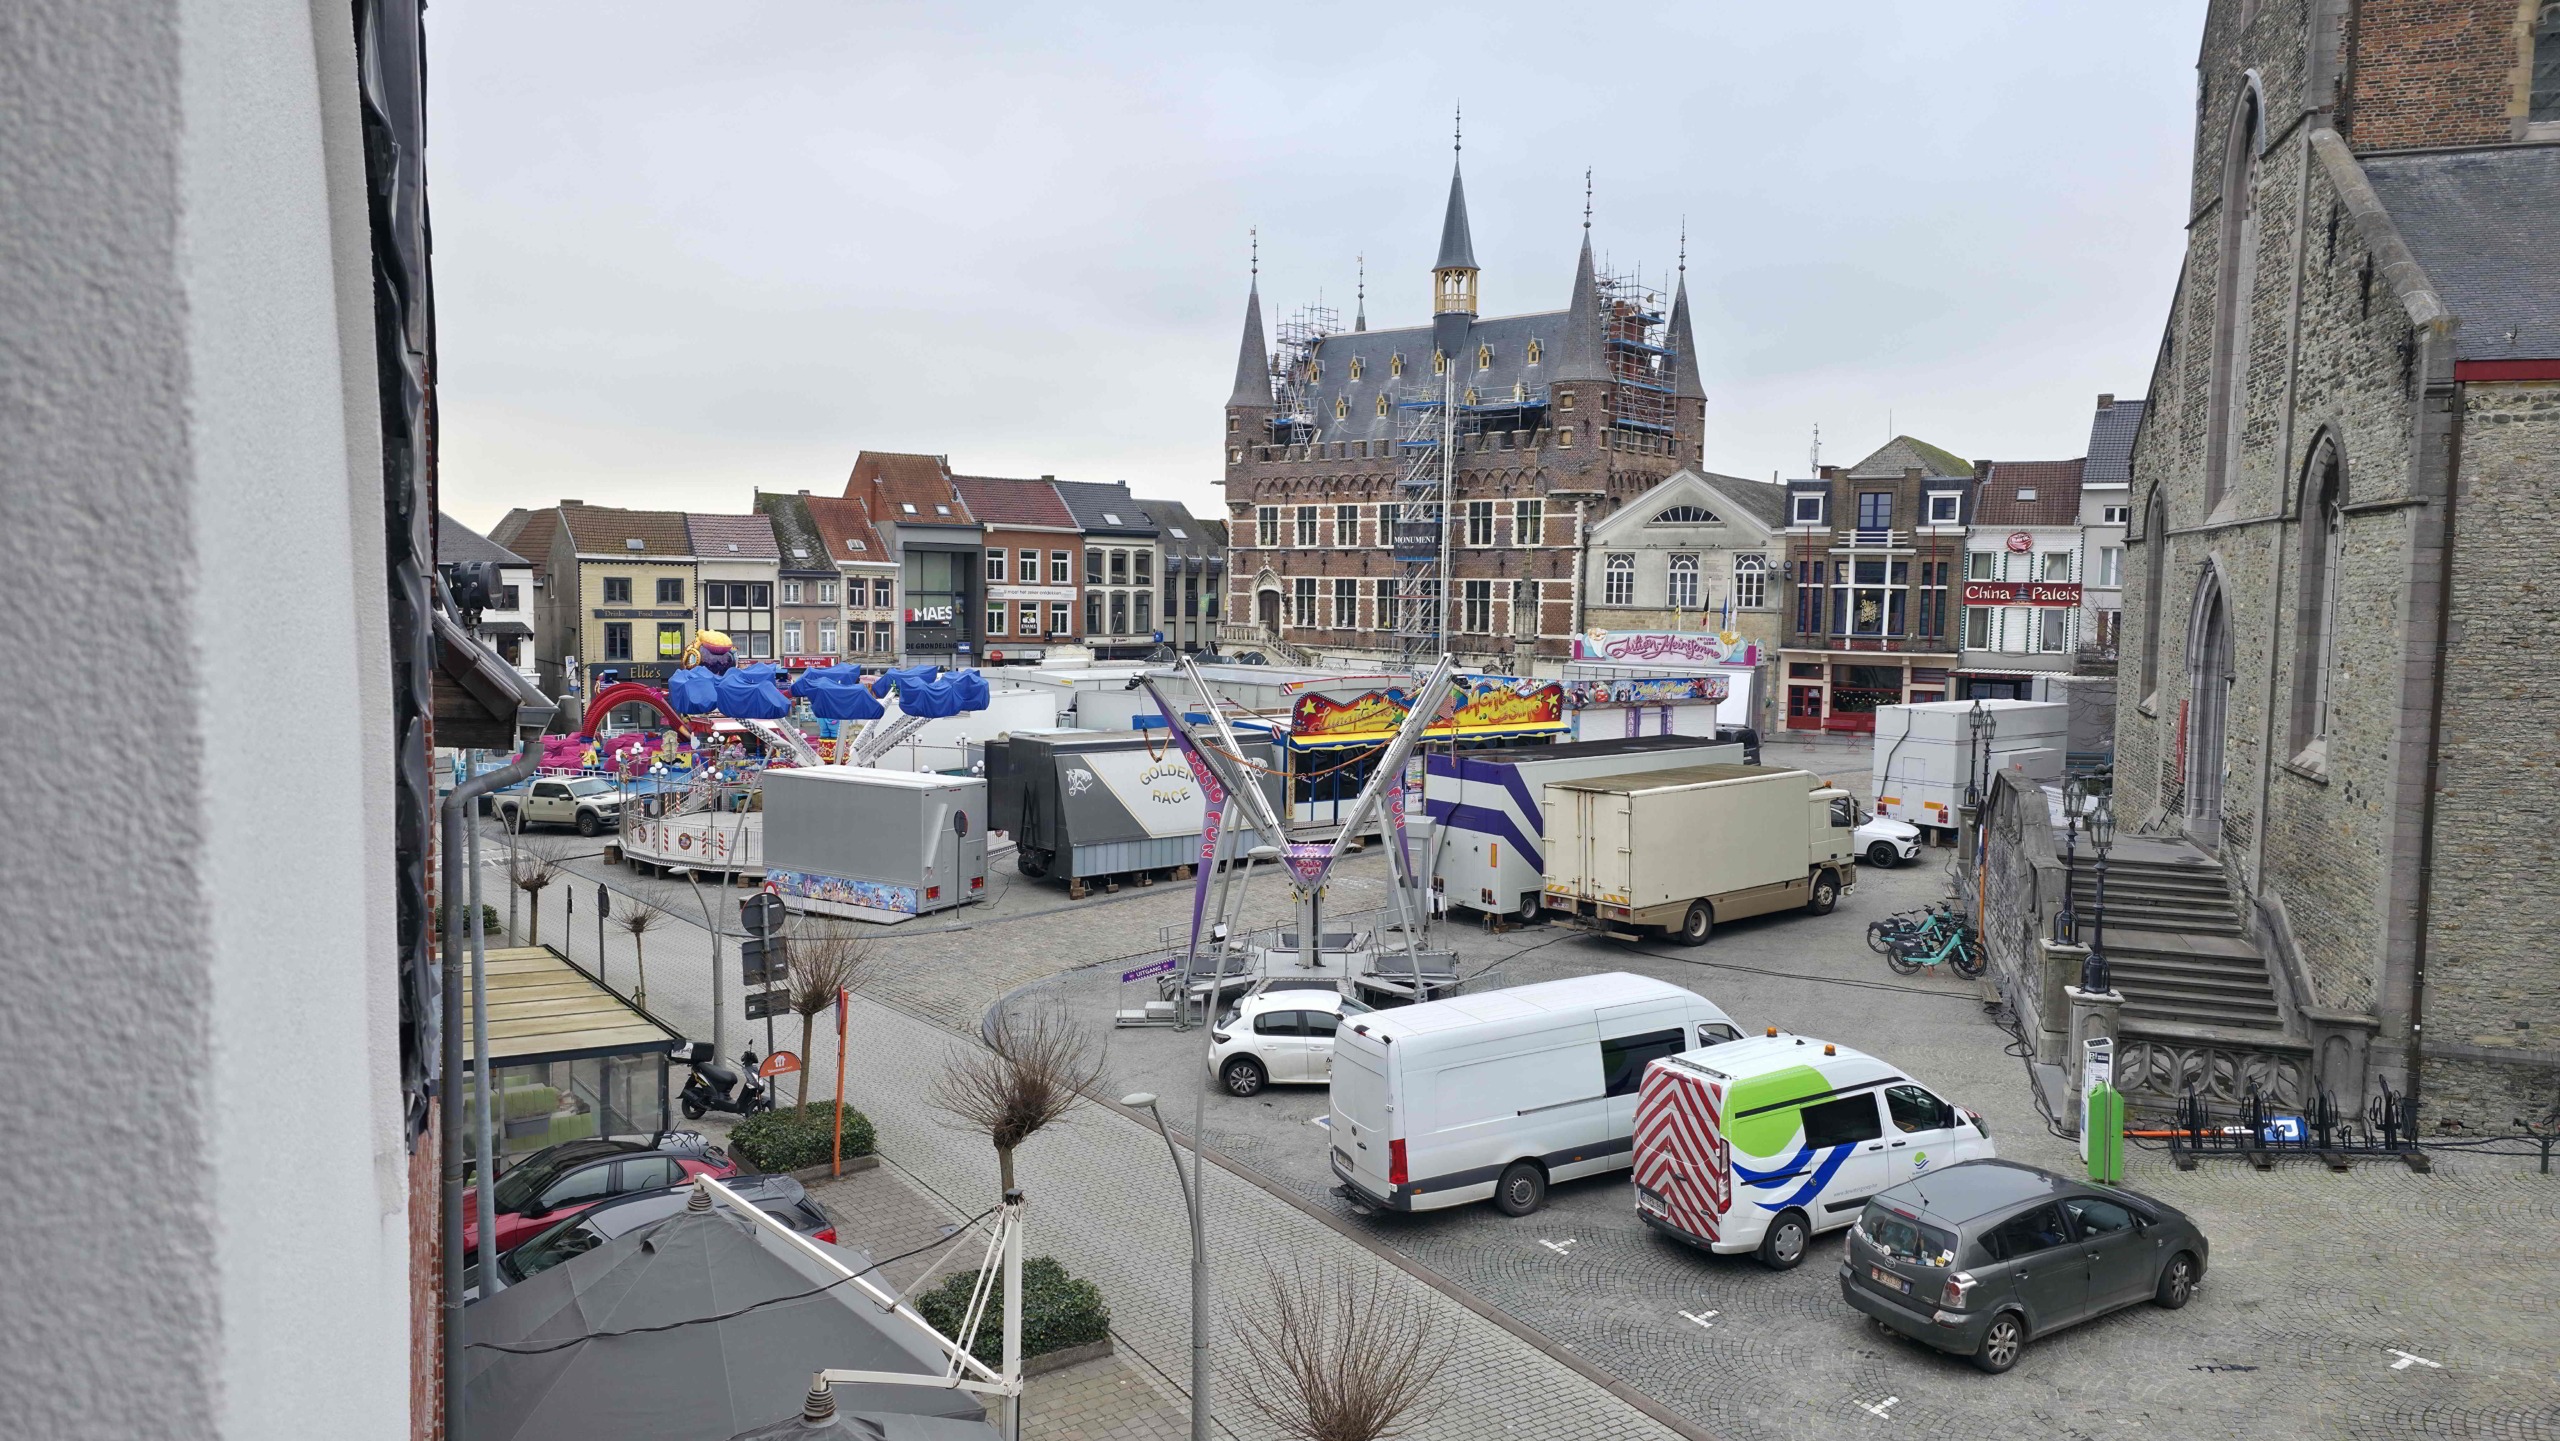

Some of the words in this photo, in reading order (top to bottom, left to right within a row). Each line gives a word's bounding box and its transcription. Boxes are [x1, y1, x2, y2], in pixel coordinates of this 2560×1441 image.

[1394, 536, 1436, 544] MONUMENT
[1966, 585, 2011, 600] China
[2032, 586, 2080, 601] Paleis
[914, 606, 953, 621] MAES
[906, 642, 914, 650] DE
[915, 642, 957, 650] GRONDELING
[630, 665, 661, 679] Ellie's
[1468, 684, 1517, 716] Monte
[1488, 698, 1543, 724] Casino
[1139, 764, 1196, 786] GOLDEN
[1152, 787, 1191, 804] RACE
[1201, 811, 1222, 859] FUN
[1135, 966, 1162, 977] UITGANG
